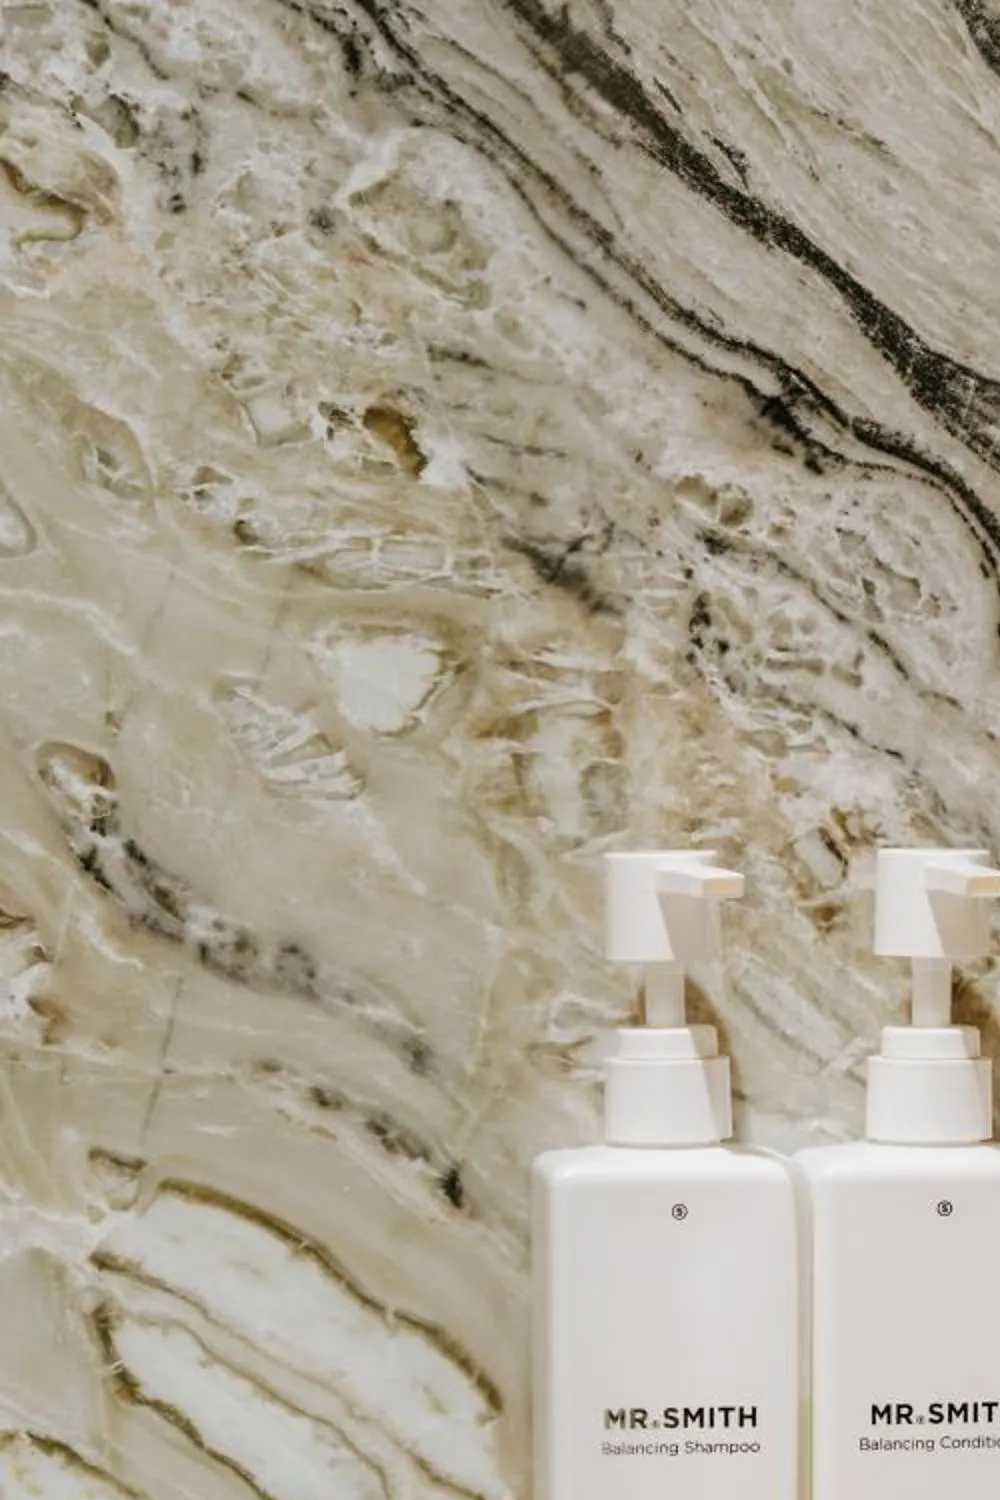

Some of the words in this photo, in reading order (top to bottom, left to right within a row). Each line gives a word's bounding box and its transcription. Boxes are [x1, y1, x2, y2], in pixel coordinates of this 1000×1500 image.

[602, 1441, 679, 1457] Balancing
[684, 1441, 761, 1455] Shampoo
[859, 1437, 935, 1453] Balancing
